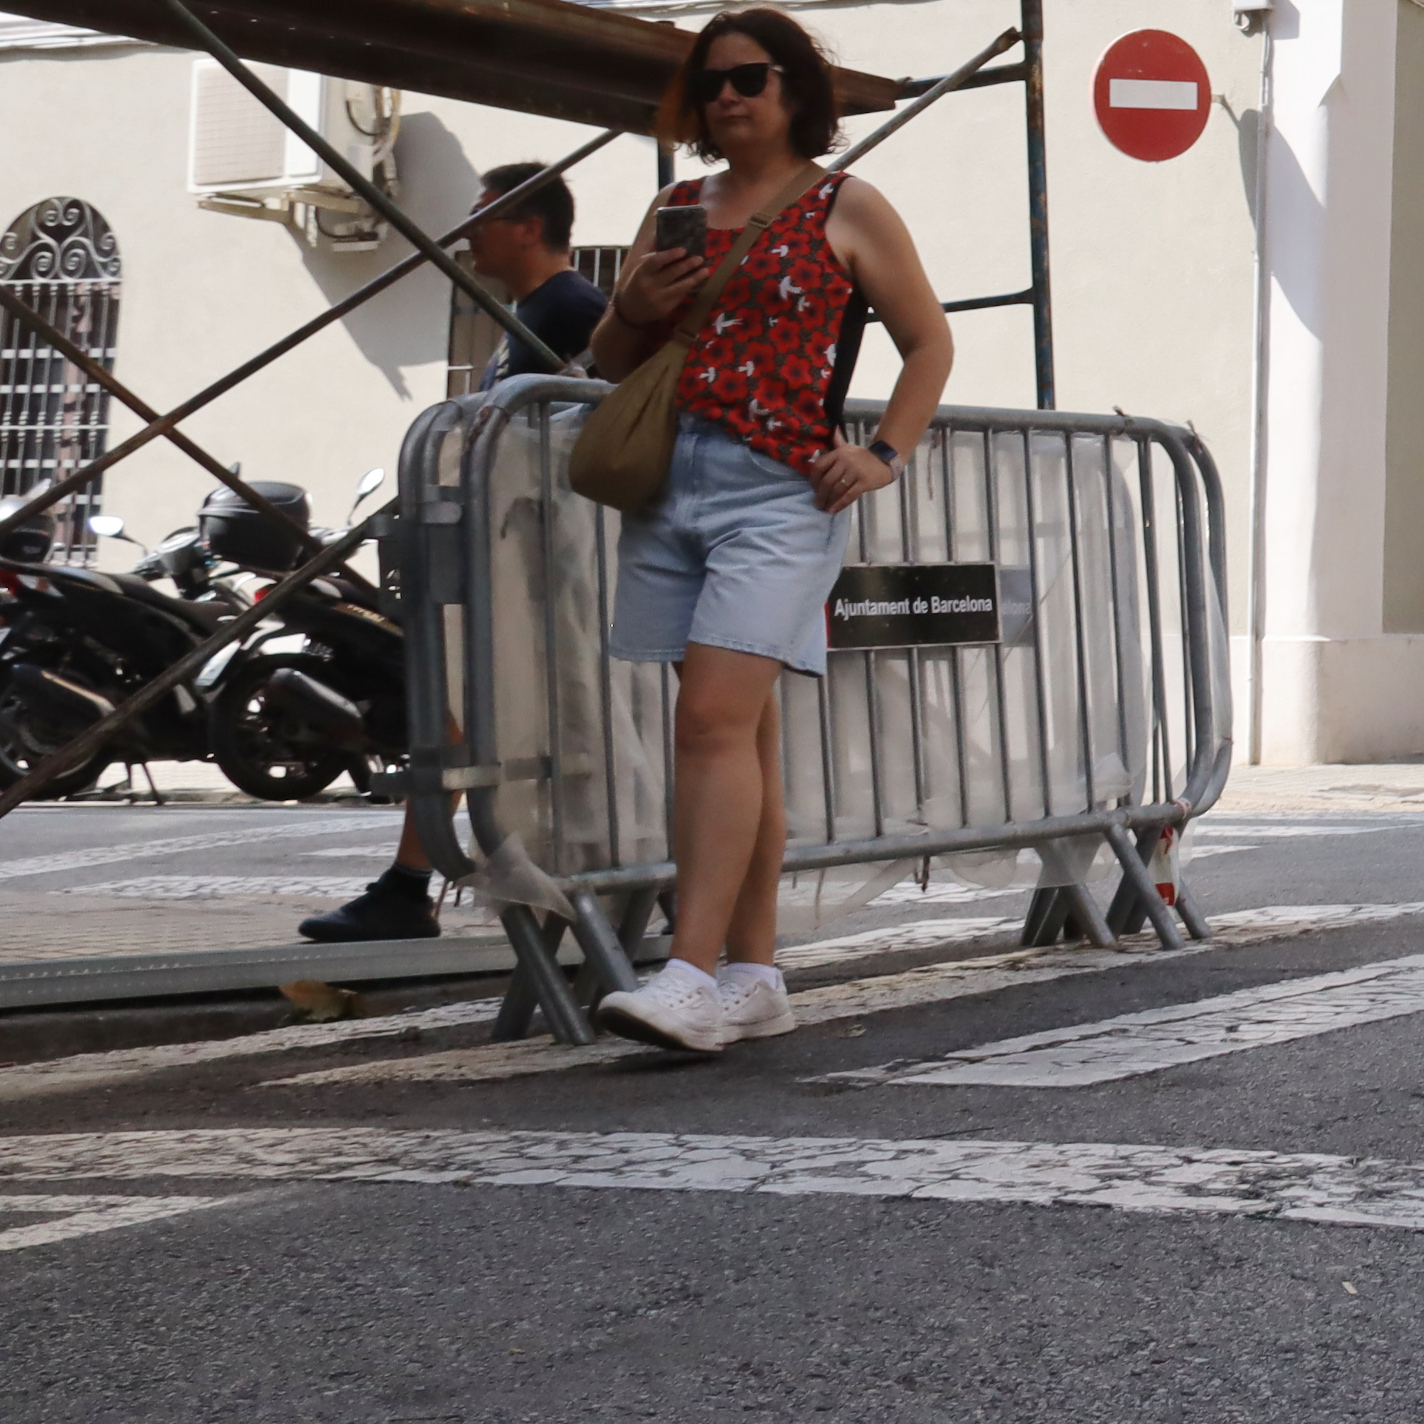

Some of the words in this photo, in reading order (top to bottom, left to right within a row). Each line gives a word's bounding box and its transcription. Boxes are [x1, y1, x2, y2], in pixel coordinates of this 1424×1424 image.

[834, 597, 910, 621] Ajuntament
[912, 597, 929, 614] de
[931, 595, 993, 614] Barcelona
